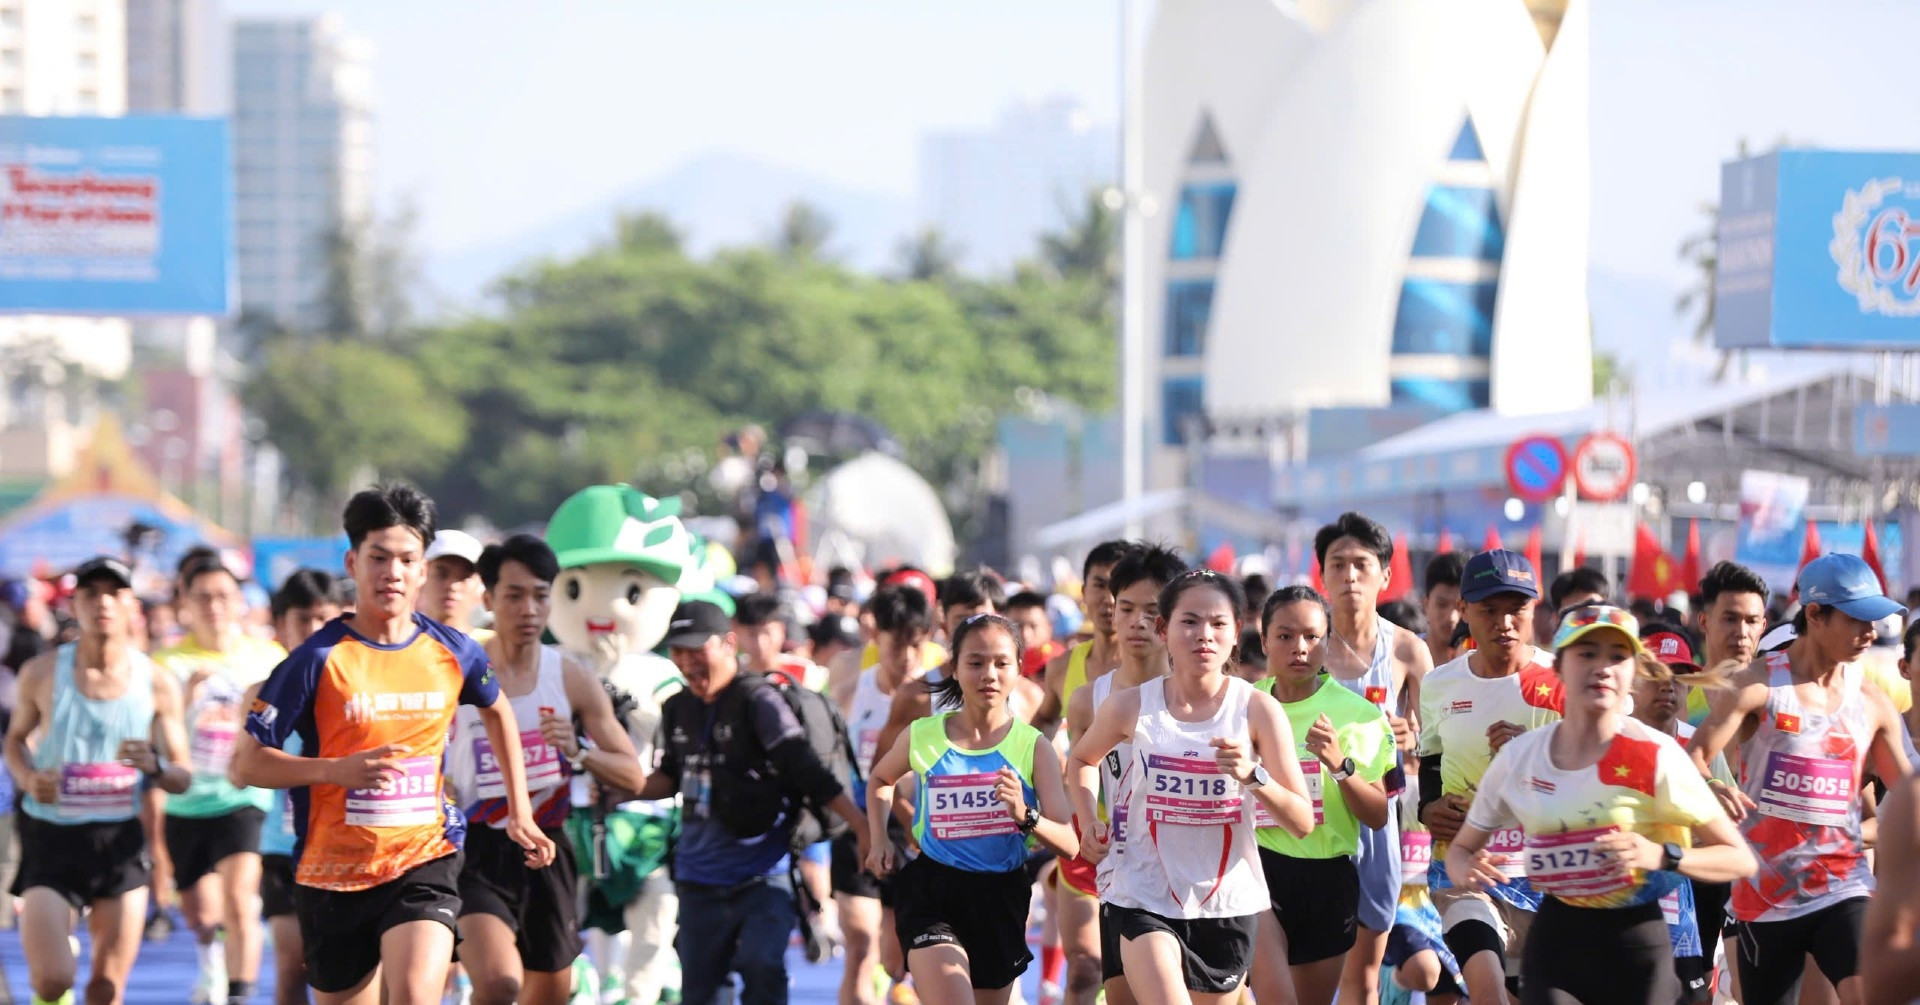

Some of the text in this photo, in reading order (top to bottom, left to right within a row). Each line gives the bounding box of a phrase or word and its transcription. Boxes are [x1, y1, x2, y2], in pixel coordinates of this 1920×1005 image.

[354, 776, 422, 796] 313
[1155, 774, 1226, 796] 52118
[1770, 769, 1838, 795] 50505
[936, 790, 1001, 810] 51459
